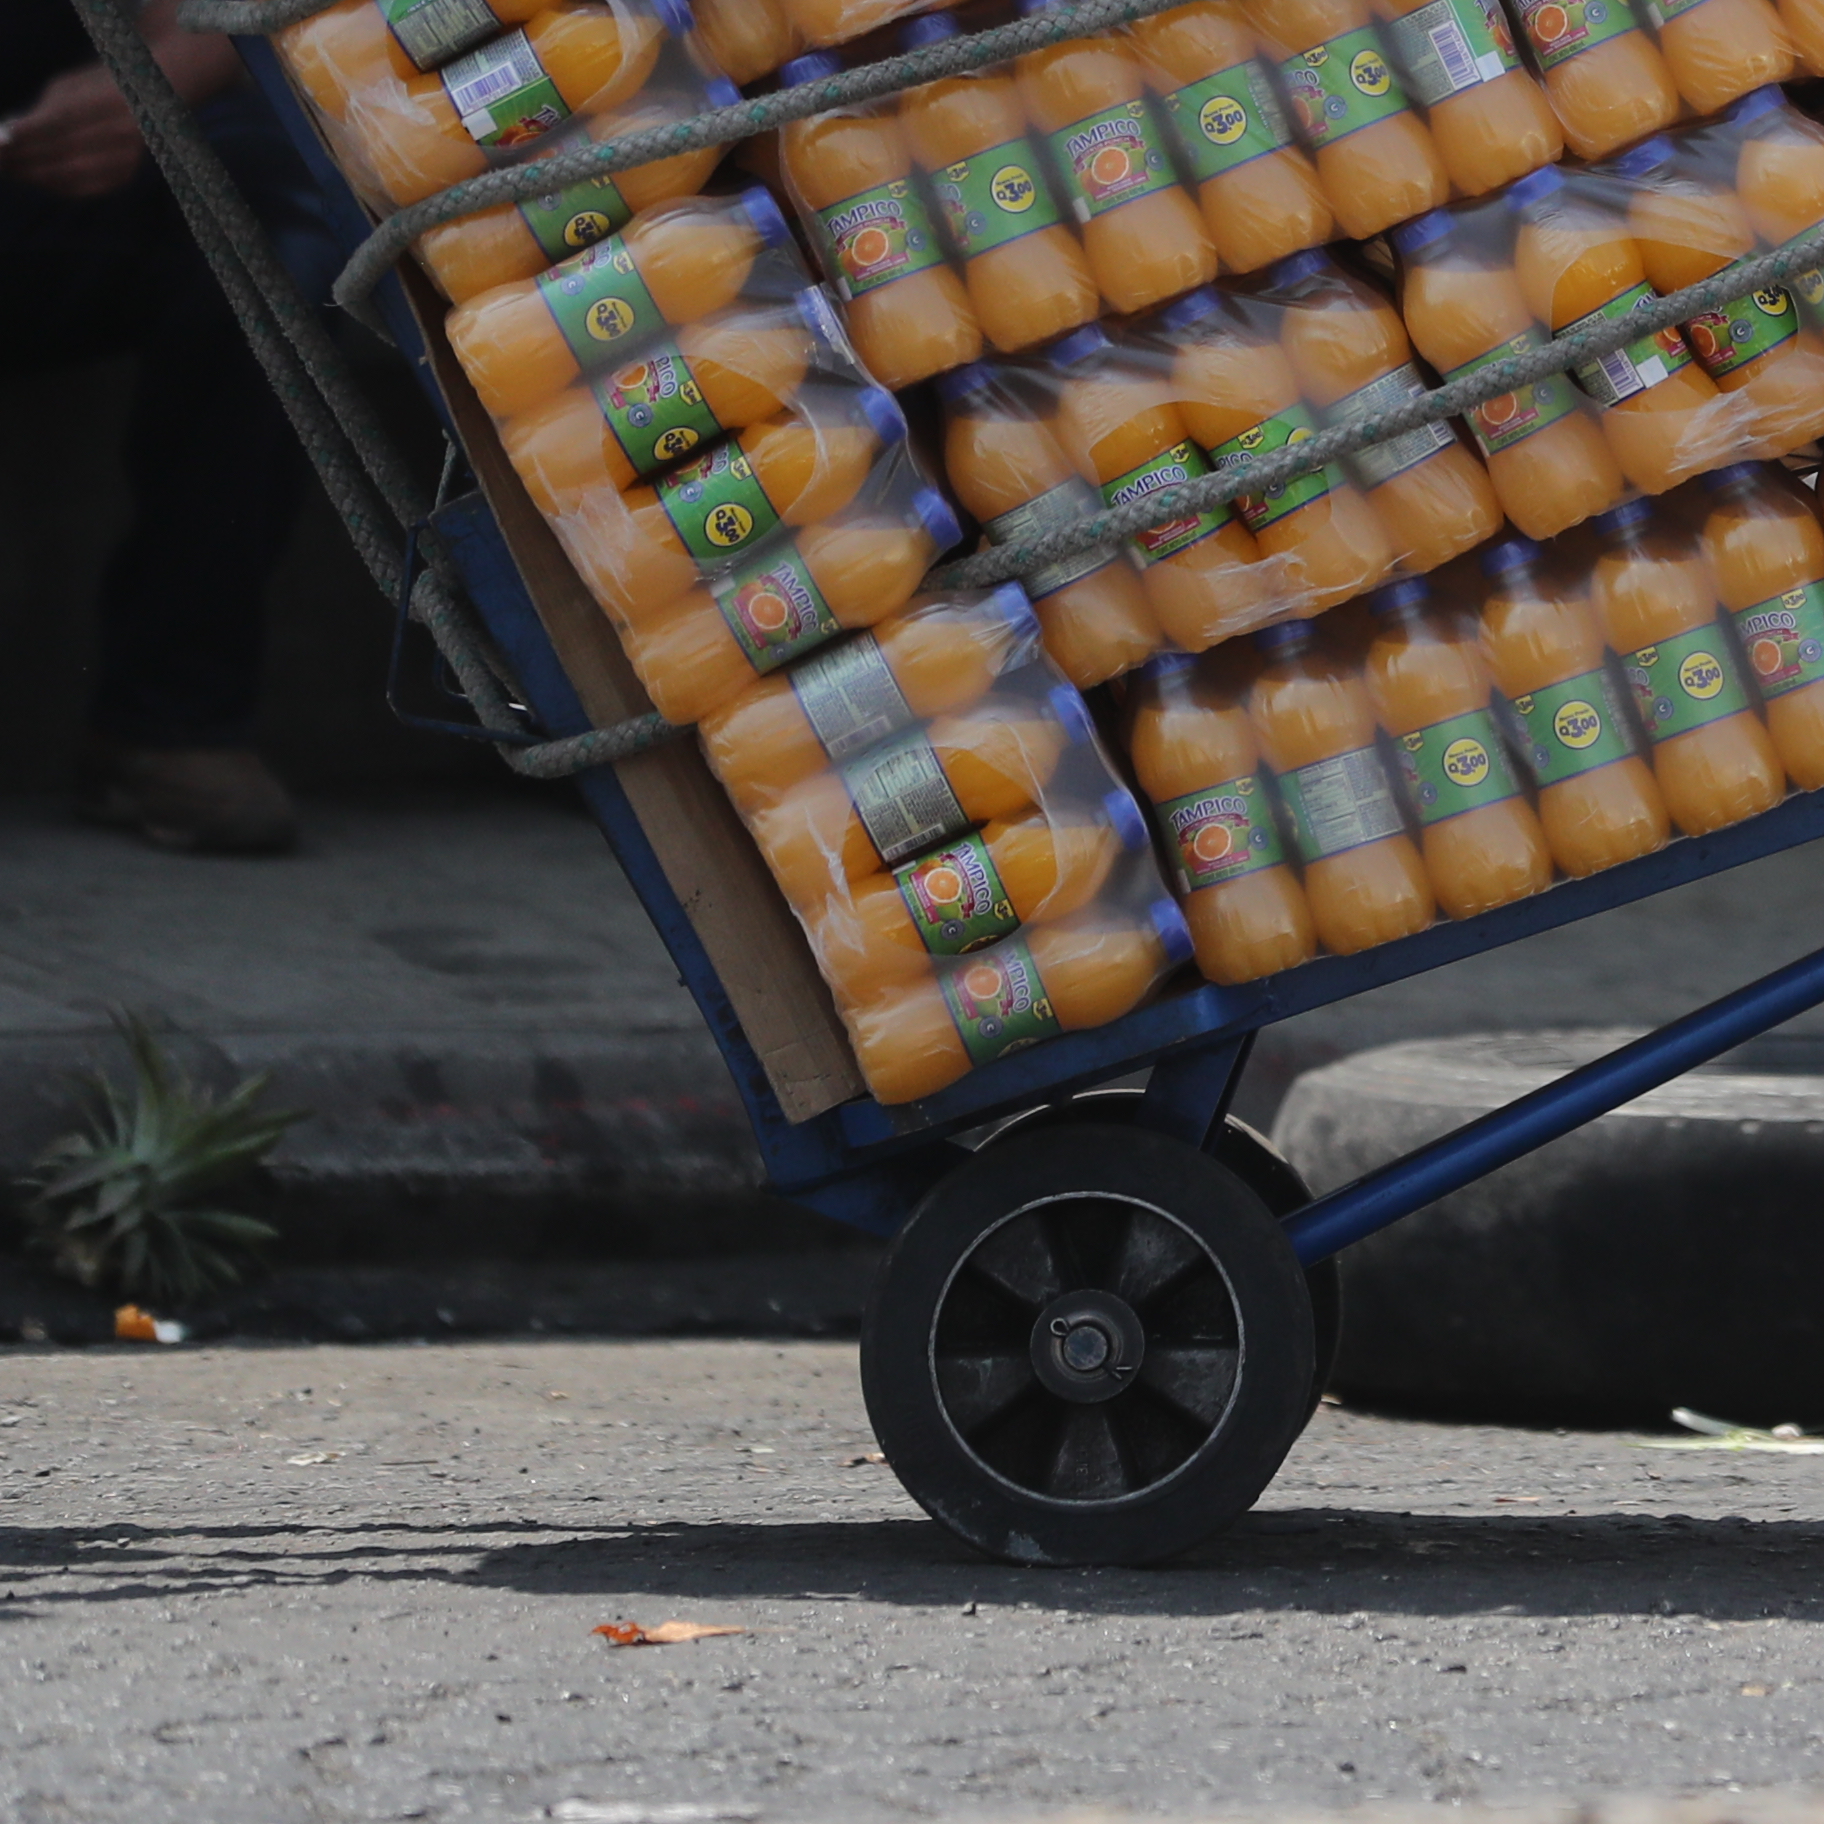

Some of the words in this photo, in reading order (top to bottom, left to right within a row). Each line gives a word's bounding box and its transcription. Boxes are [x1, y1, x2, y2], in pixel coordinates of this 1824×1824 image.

[1065, 119, 1141, 156] TAMPICO
[1205, 110, 1243, 135] Q3.00
[826, 200, 902, 238] TAMPICO
[655, 354, 677, 399] PICO
[1218, 452, 1253, 470] PICO
[1111, 466, 1188, 506] TAMPICO
[771, 561, 819, 635] TAMPICO
[1740, 611, 1796, 636] MPICO
[1169, 797, 1247, 831] TAMPICO
[952, 841, 991, 915] TAMPICO
[1006, 953, 1030, 1013] MPICO
